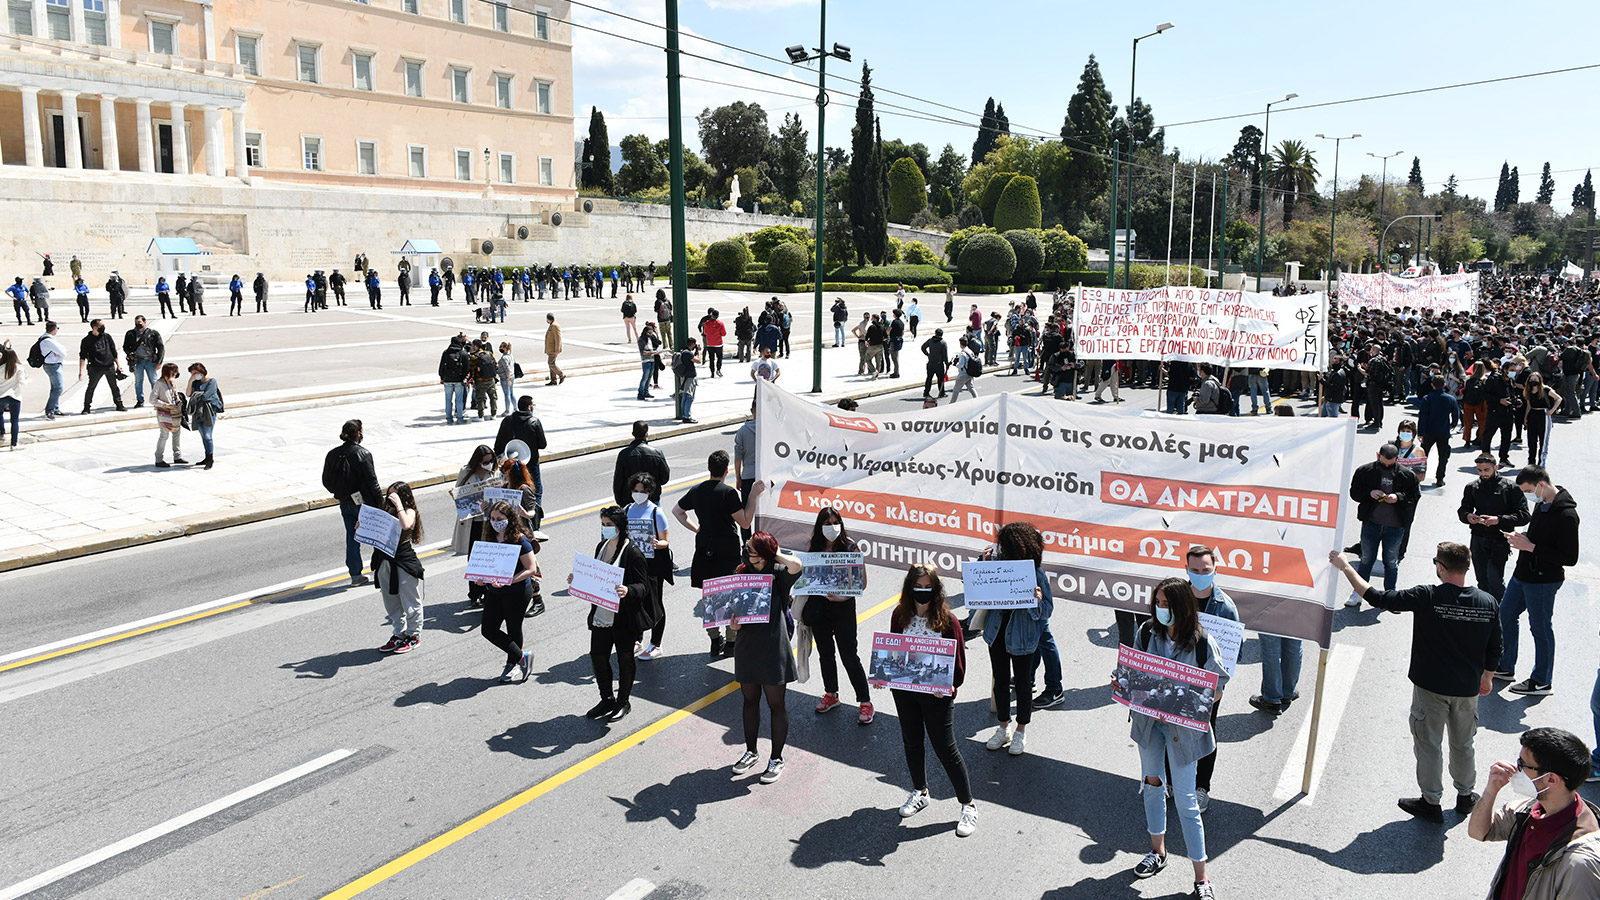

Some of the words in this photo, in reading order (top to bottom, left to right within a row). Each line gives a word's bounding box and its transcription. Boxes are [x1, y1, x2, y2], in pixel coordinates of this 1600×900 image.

[1082, 290, 1102, 301] ΕΞΩ
[1108, 290, 1116, 302] Η
[1175, 290, 1194, 300] ΑΠΟ
[1200, 291, 1210, 301] ΤΟ
[1216, 291, 1242, 303] ΕΜΠ
[1081, 302, 1091, 313] ΟΙ
[1134, 302, 1148, 314] ΤΗΣ
[1091, 314, 1110, 326] ΔΕΝ
[1112, 314, 1132, 324] ΜΑΣ
[1078, 325, 1110, 336] ΠΑΡΤΕ
[1118, 325, 1139, 336] ΤΩΡΑ
[1080, 338, 1132, 354] ΦΟΙΤΗΤΕΣ
[1140, 338, 1204, 356] ΕΡΓΑΖΟΜΕΝΟΙ
[1247, 346, 1265, 361] ΣΤΟ
[1268, 348, 1298, 362] ΝΟΜΟ
[901, 415, 998, 438] αστυνομία
[1006, 421, 1053, 440] από
[1061, 428, 1092, 448] τις
[1100, 430, 1192, 459] σχολές
[1199, 442, 1250, 465] μας
[774, 442, 791, 458] Ο
[796, 446, 848, 472] νόμος
[1109, 479, 1149, 504] ΘΑ
[1156, 486, 1330, 523] ΑΝΑΤΡΑΠΕΙ
[794, 490, 803, 506] 1
[808, 494, 876, 520] χρόνος
[886, 502, 960, 529] κλειστά
[967, 512, 1124, 554] Πανστήμια
[1138, 537, 1180, 562] ΩΣ
[876, 636, 884, 644] ΩΣ
[886, 638, 900, 646] ΕΔΩ!
[1128, 659, 1142, 668] ΕΙΝΑΙ
[1143, 664, 1179, 679] ΕΓΚΛΗΜΑΤΙΕΣ
[1186, 676, 1214, 688] ΦΟΙΤΗΤΕΣ
[1134, 652, 1164, 666] ΑΣΤΥΝΟΜΙΑ
[1165, 662, 1176, 670] ΑΠΟ
[1186, 668, 1206, 678] ΣΧΟΛΕΣ
[1184, 720, 1206, 730] ΑΘΗΝΑΣ
